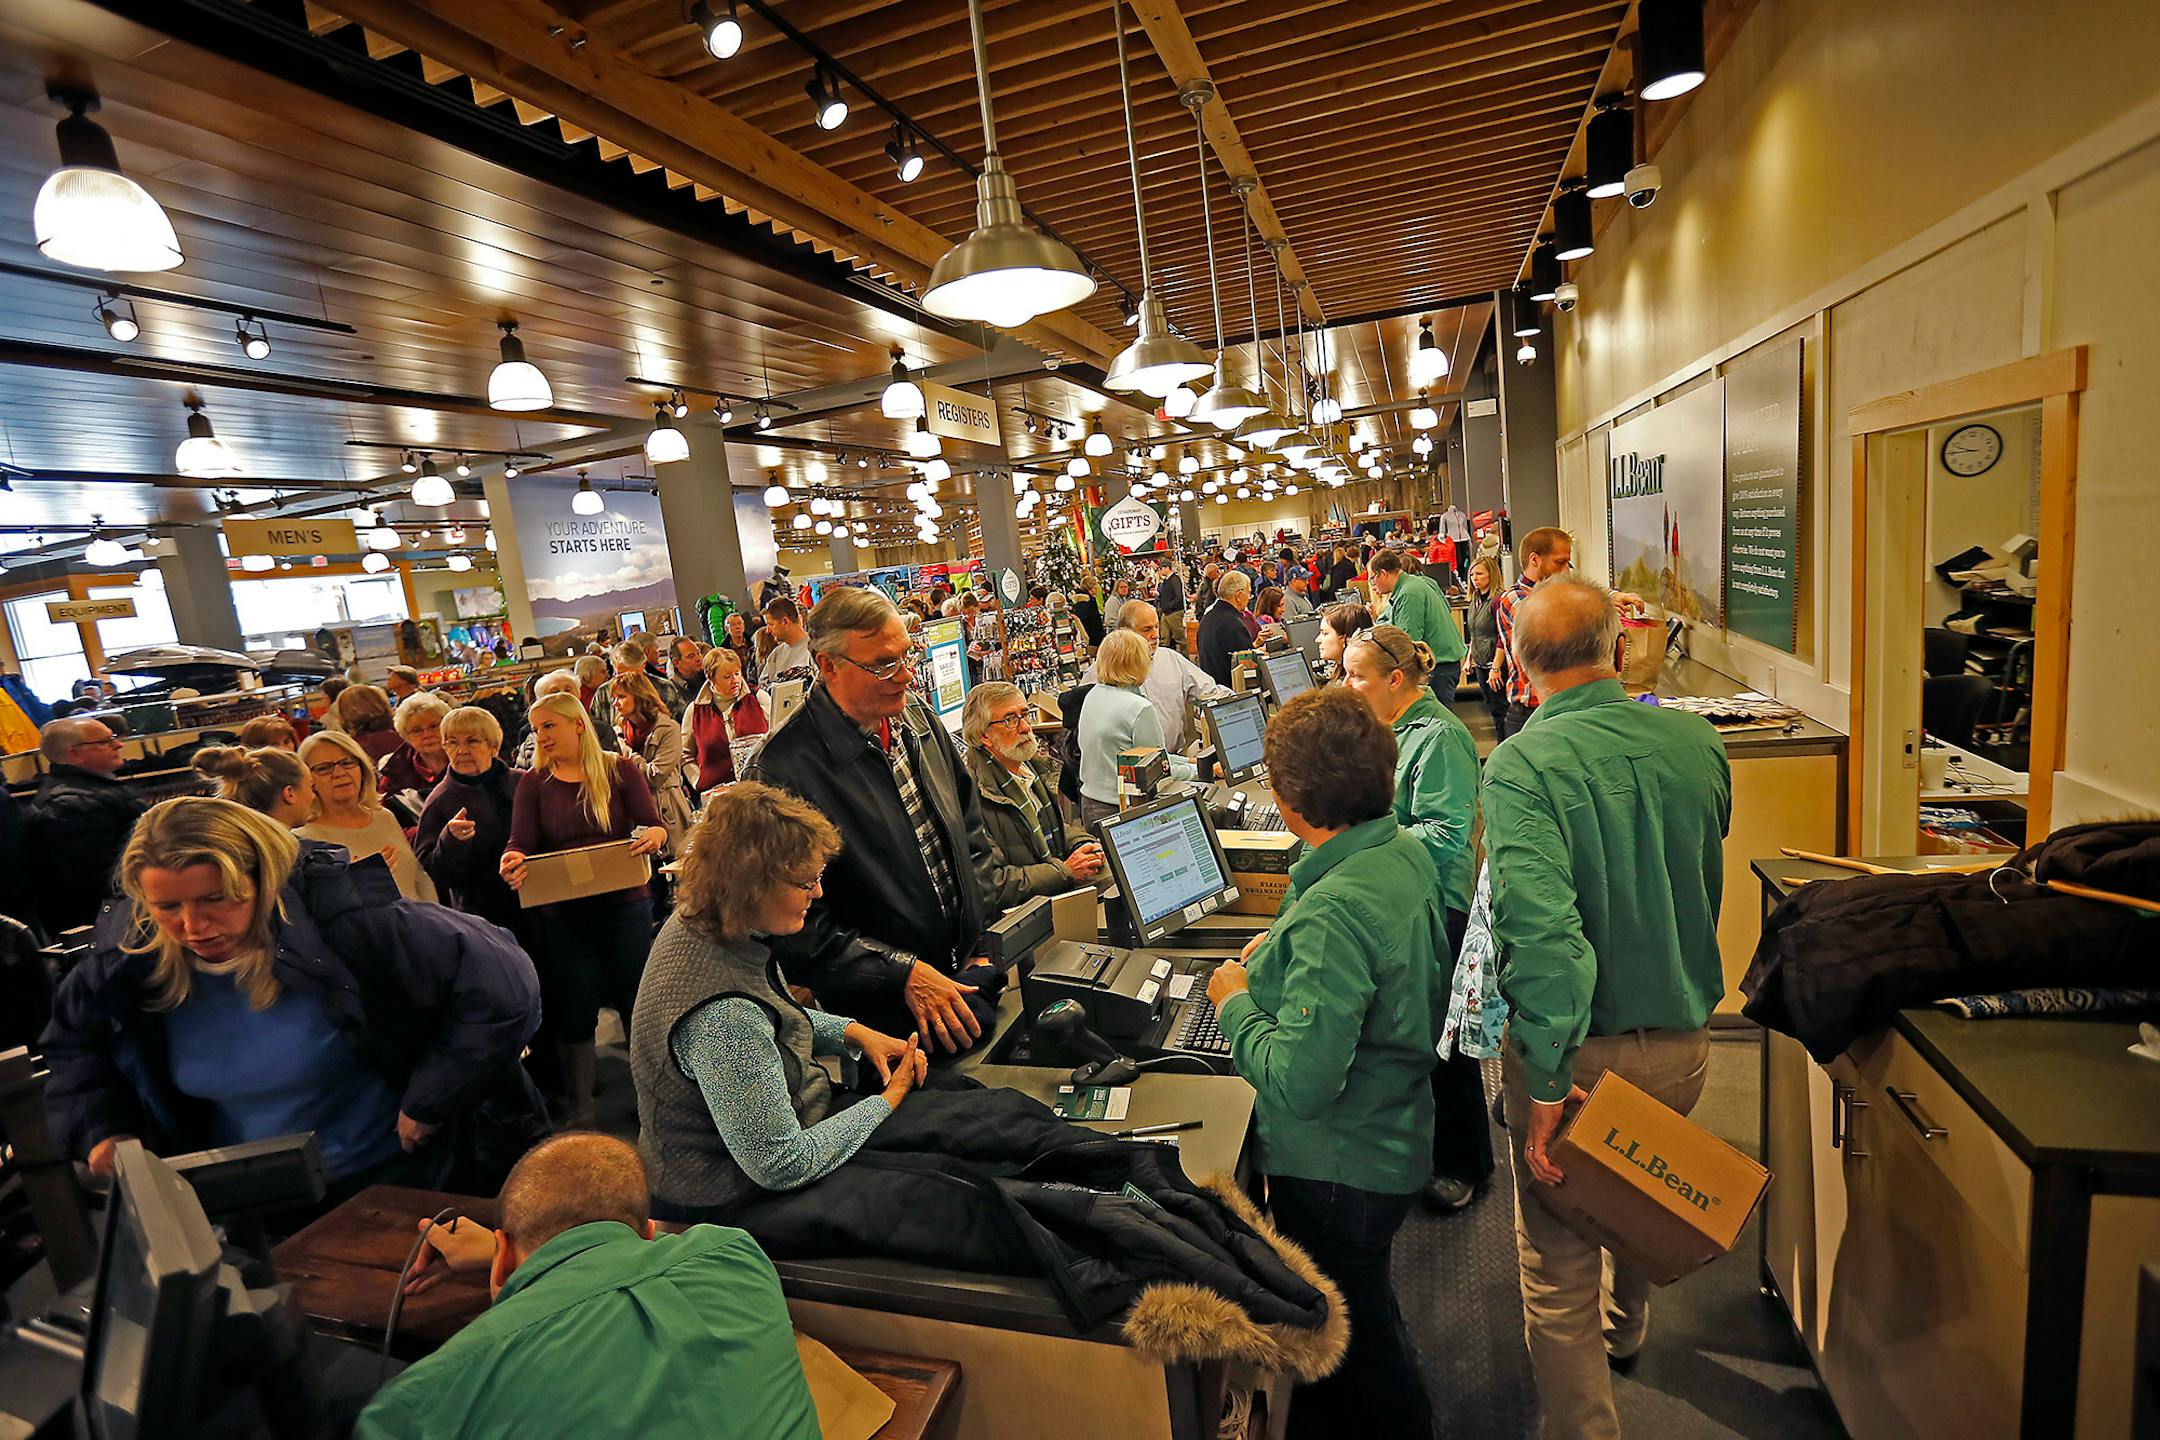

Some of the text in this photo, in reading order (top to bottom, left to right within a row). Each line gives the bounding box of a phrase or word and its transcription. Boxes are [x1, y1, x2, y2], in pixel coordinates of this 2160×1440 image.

[937, 400, 990, 429] REGISTERS
[545, 520, 647, 536] YOUR ADVENTURE
[1110, 514, 1151, 530] GIFTS
[267, 530, 322, 545] MEN'S
[550, 538, 632, 554] STARTS HERE
[58, 604, 127, 618] EQUIPMENT
